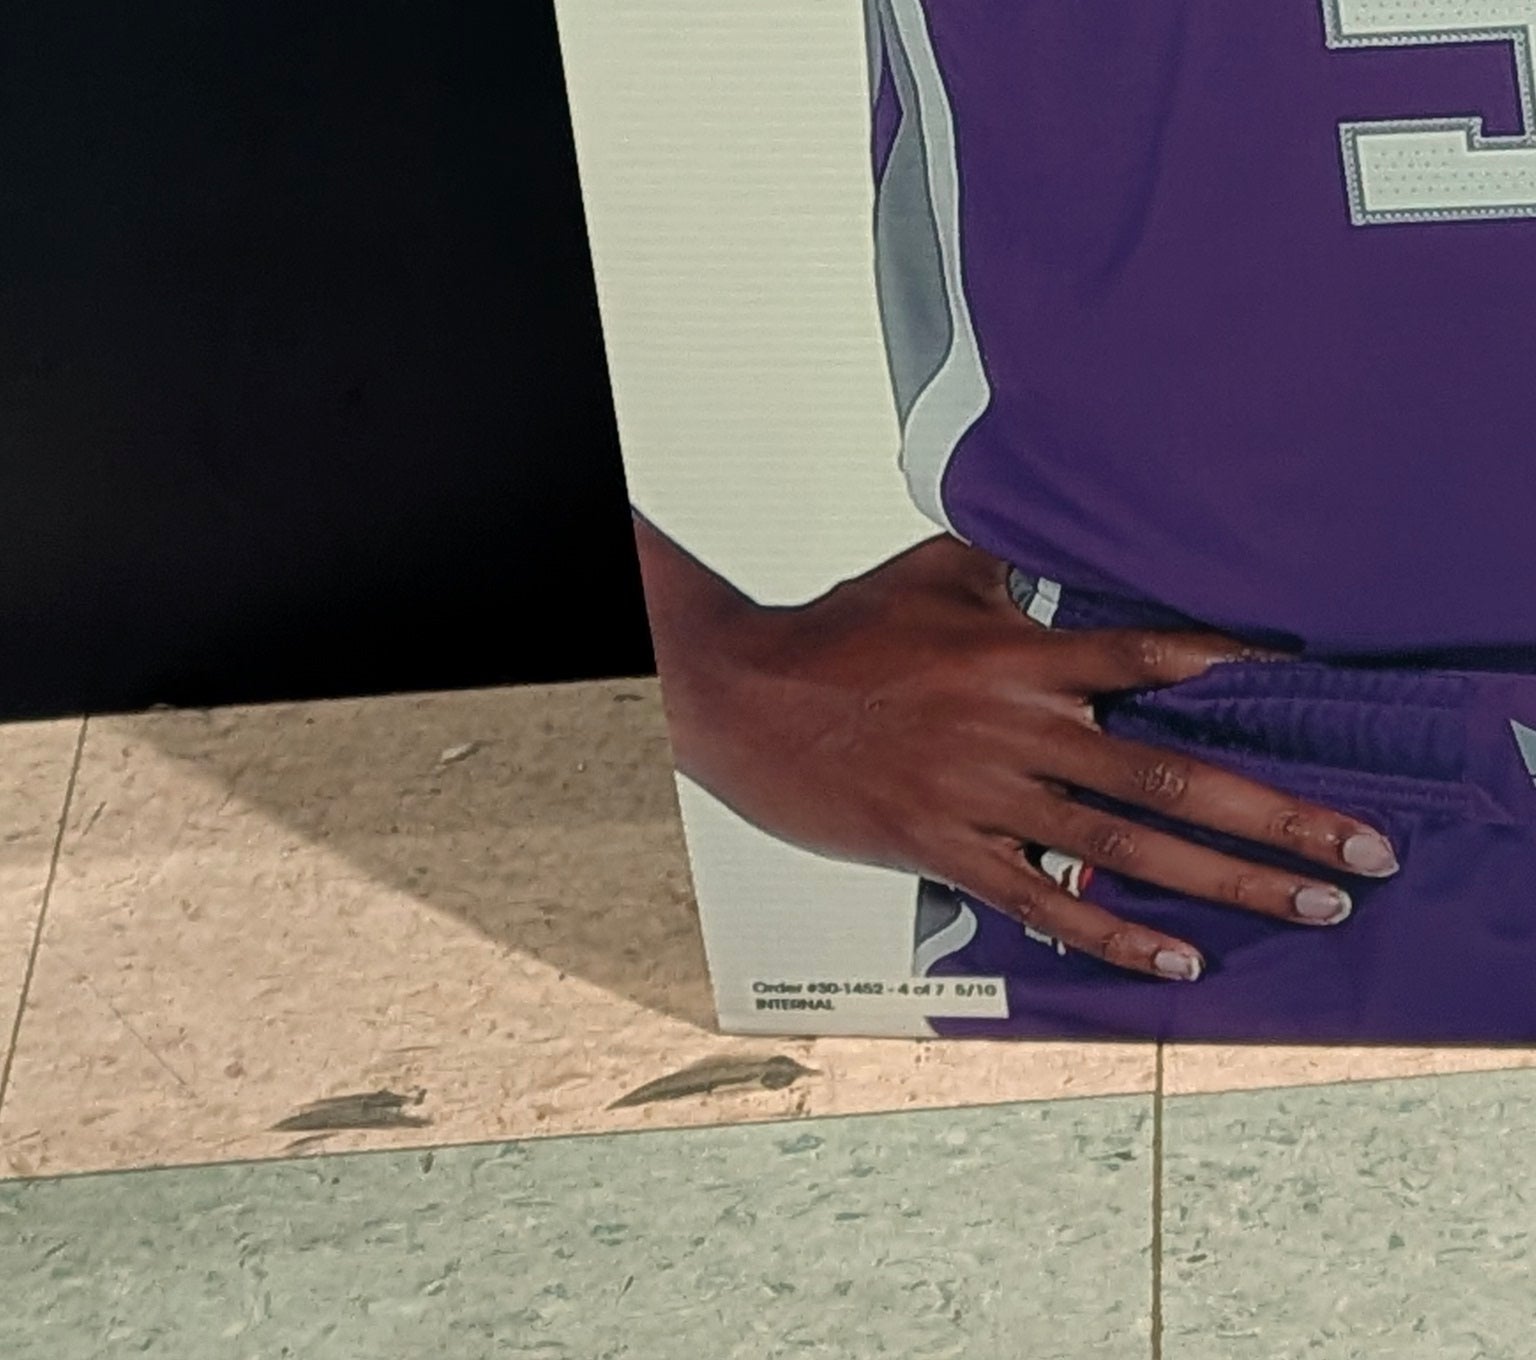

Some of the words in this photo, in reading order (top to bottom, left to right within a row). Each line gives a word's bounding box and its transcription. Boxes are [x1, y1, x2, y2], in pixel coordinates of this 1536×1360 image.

[752, 982, 802, 994] Order
[913, 983, 931, 995] of
[935, 984, 945, 996] 7
[755, 998, 836, 1011] INTERNAL
